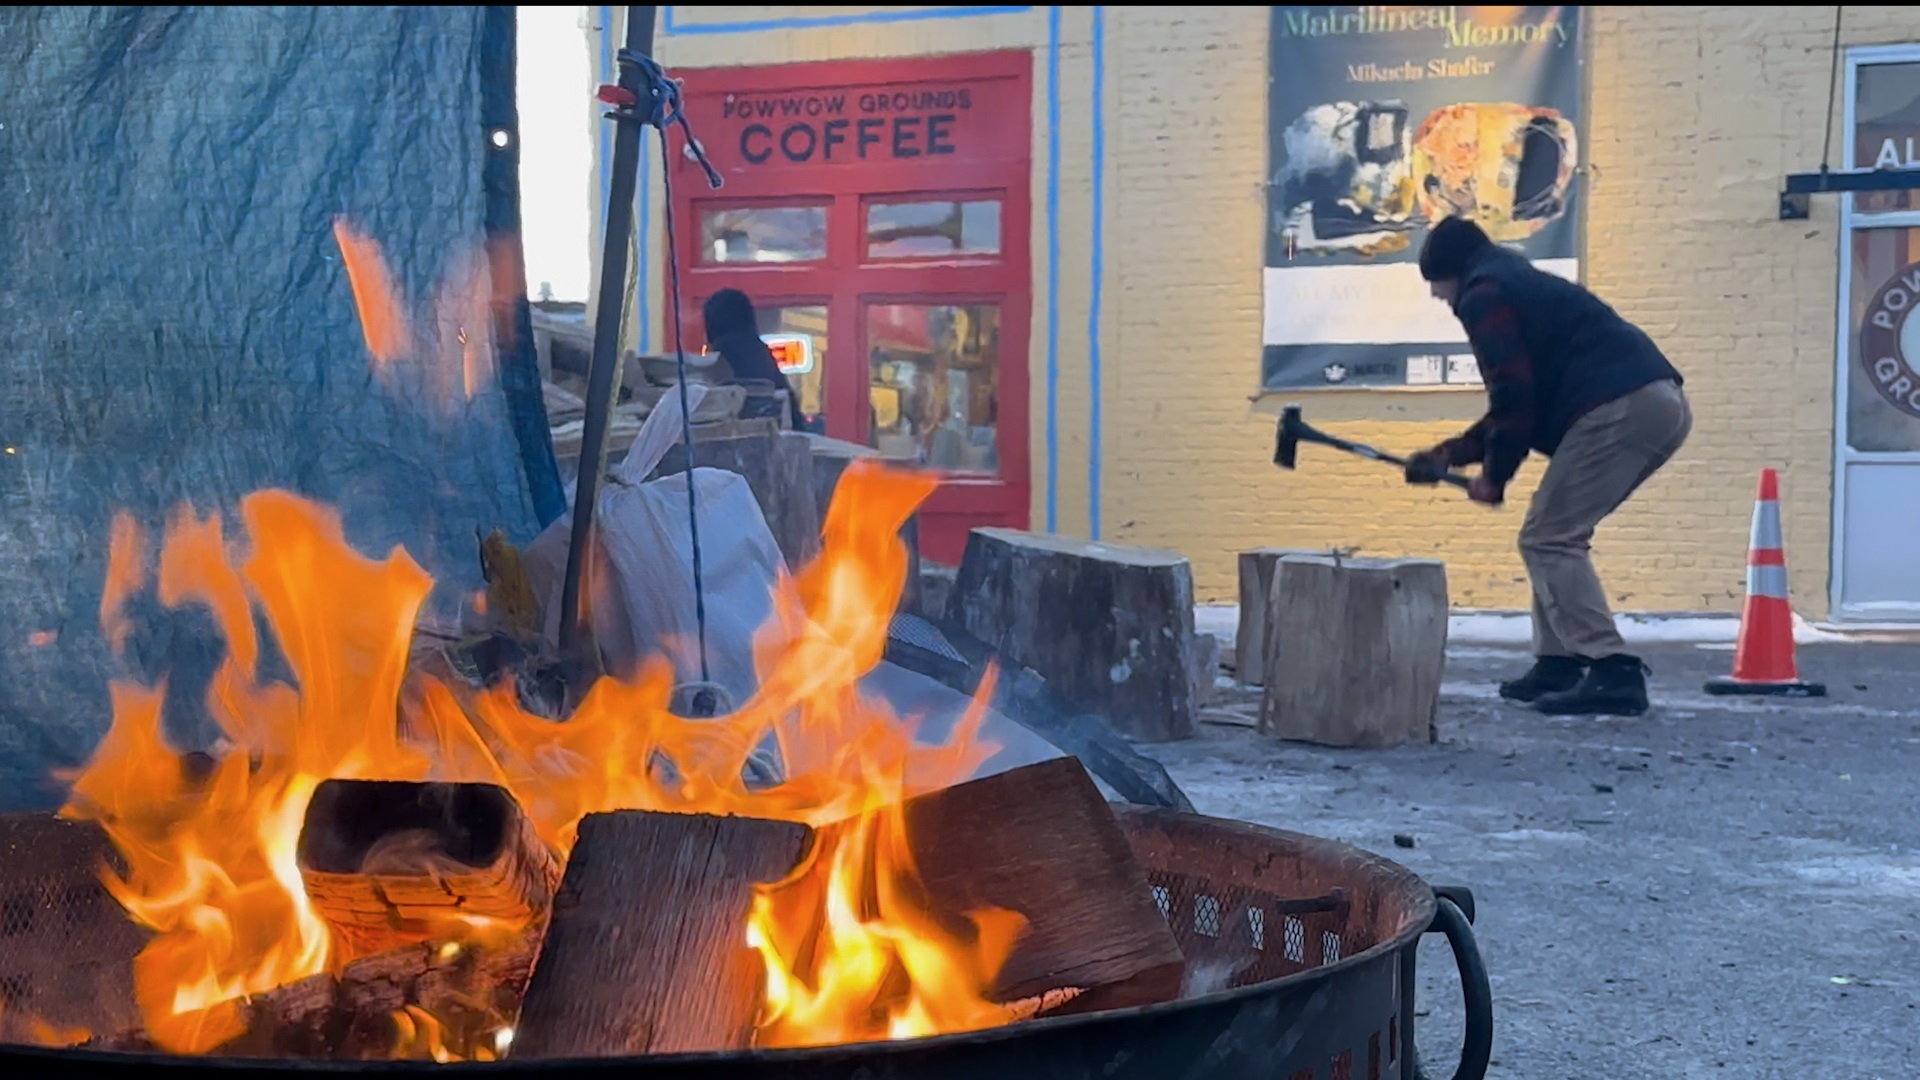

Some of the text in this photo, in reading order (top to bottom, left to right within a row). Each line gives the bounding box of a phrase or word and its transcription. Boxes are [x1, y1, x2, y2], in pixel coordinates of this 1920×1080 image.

[1443, 20, 1568, 48] Memory
[723, 88, 972, 119] POWWOW GROUNDS
[739, 114, 957, 164] COFFEE
